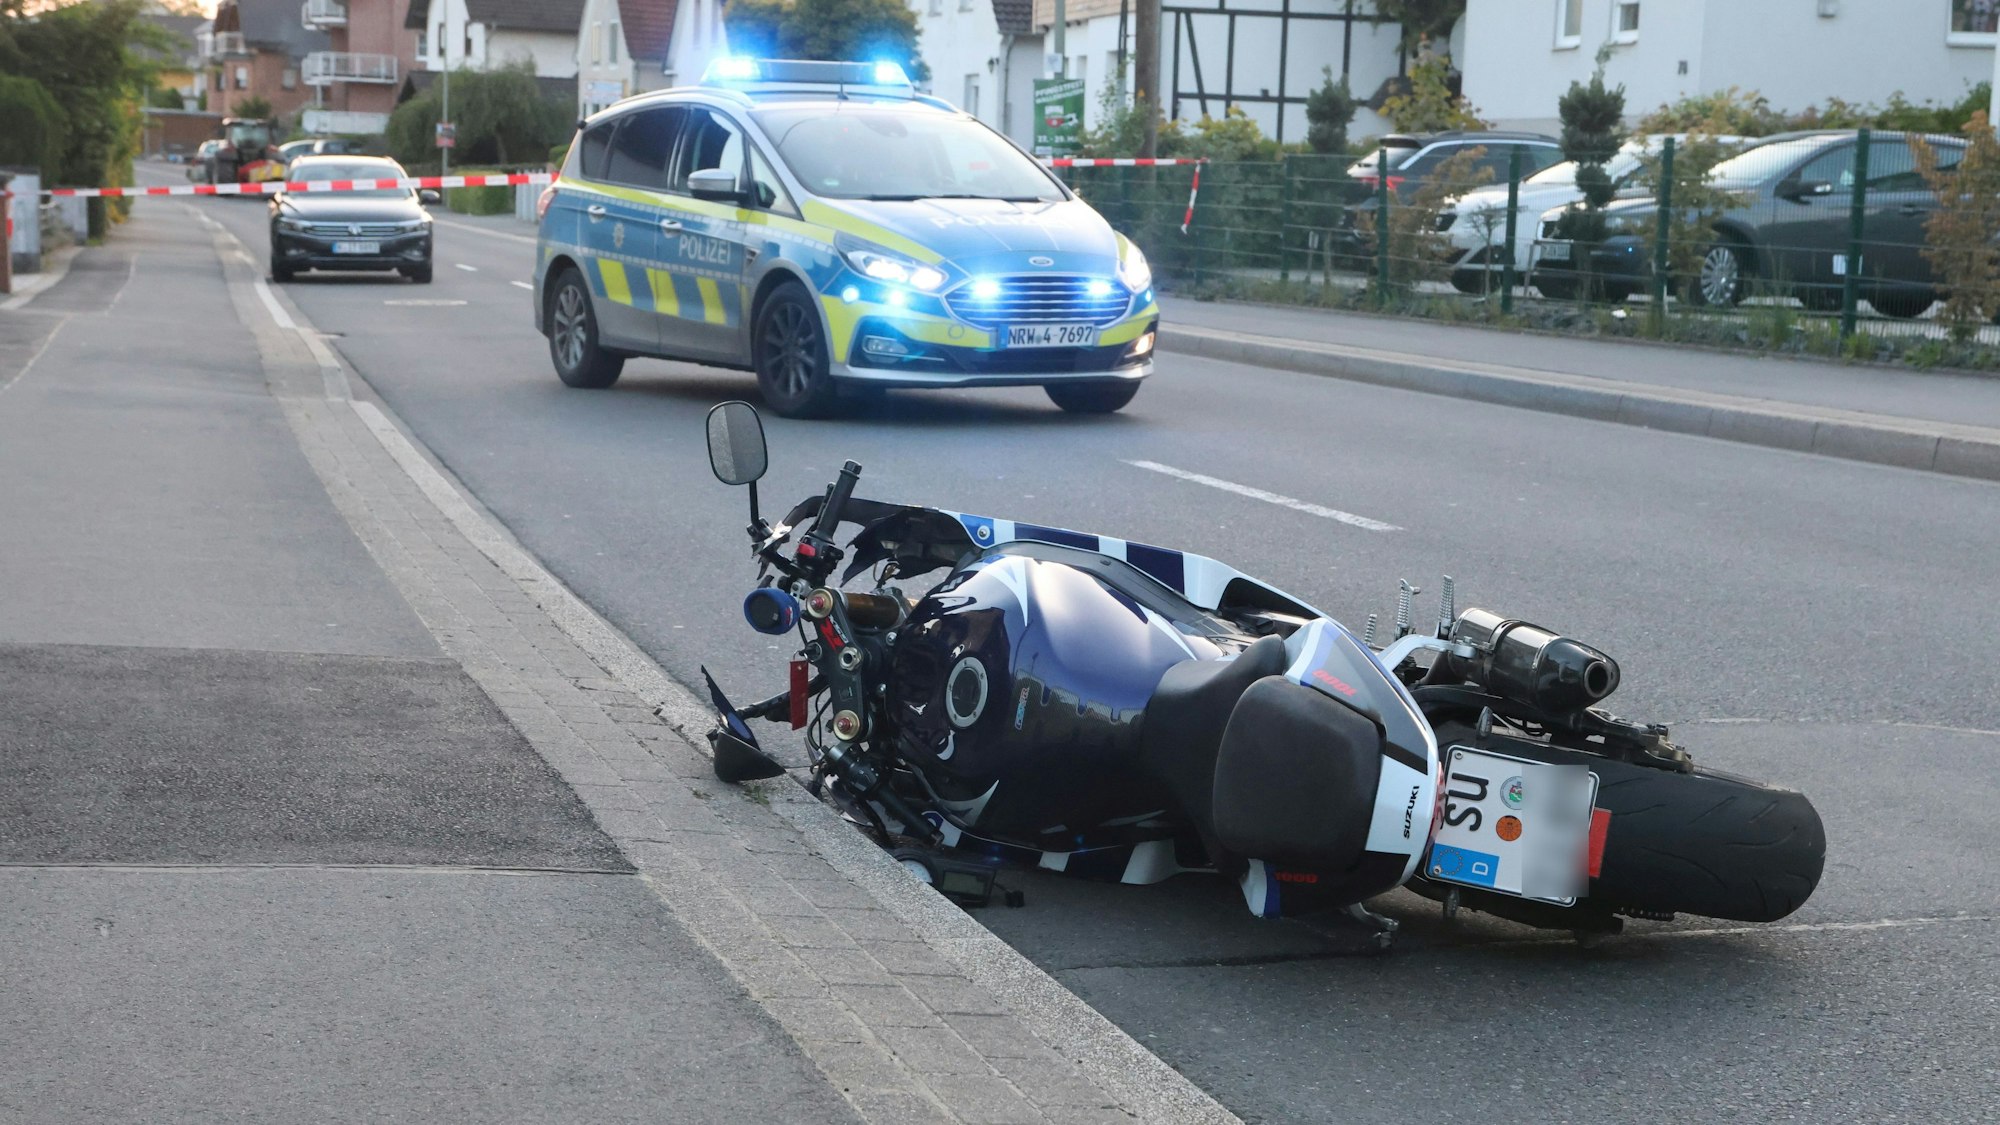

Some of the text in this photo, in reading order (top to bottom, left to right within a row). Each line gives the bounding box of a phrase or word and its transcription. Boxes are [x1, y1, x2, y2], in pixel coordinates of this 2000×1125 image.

[679, 235, 732, 264] POLIZEI
[1008, 325, 1035, 344] NRW
[1403, 785, 1420, 840] SUZUKI
[1444, 773, 1490, 832] SU
[1472, 862, 1489, 876] D
